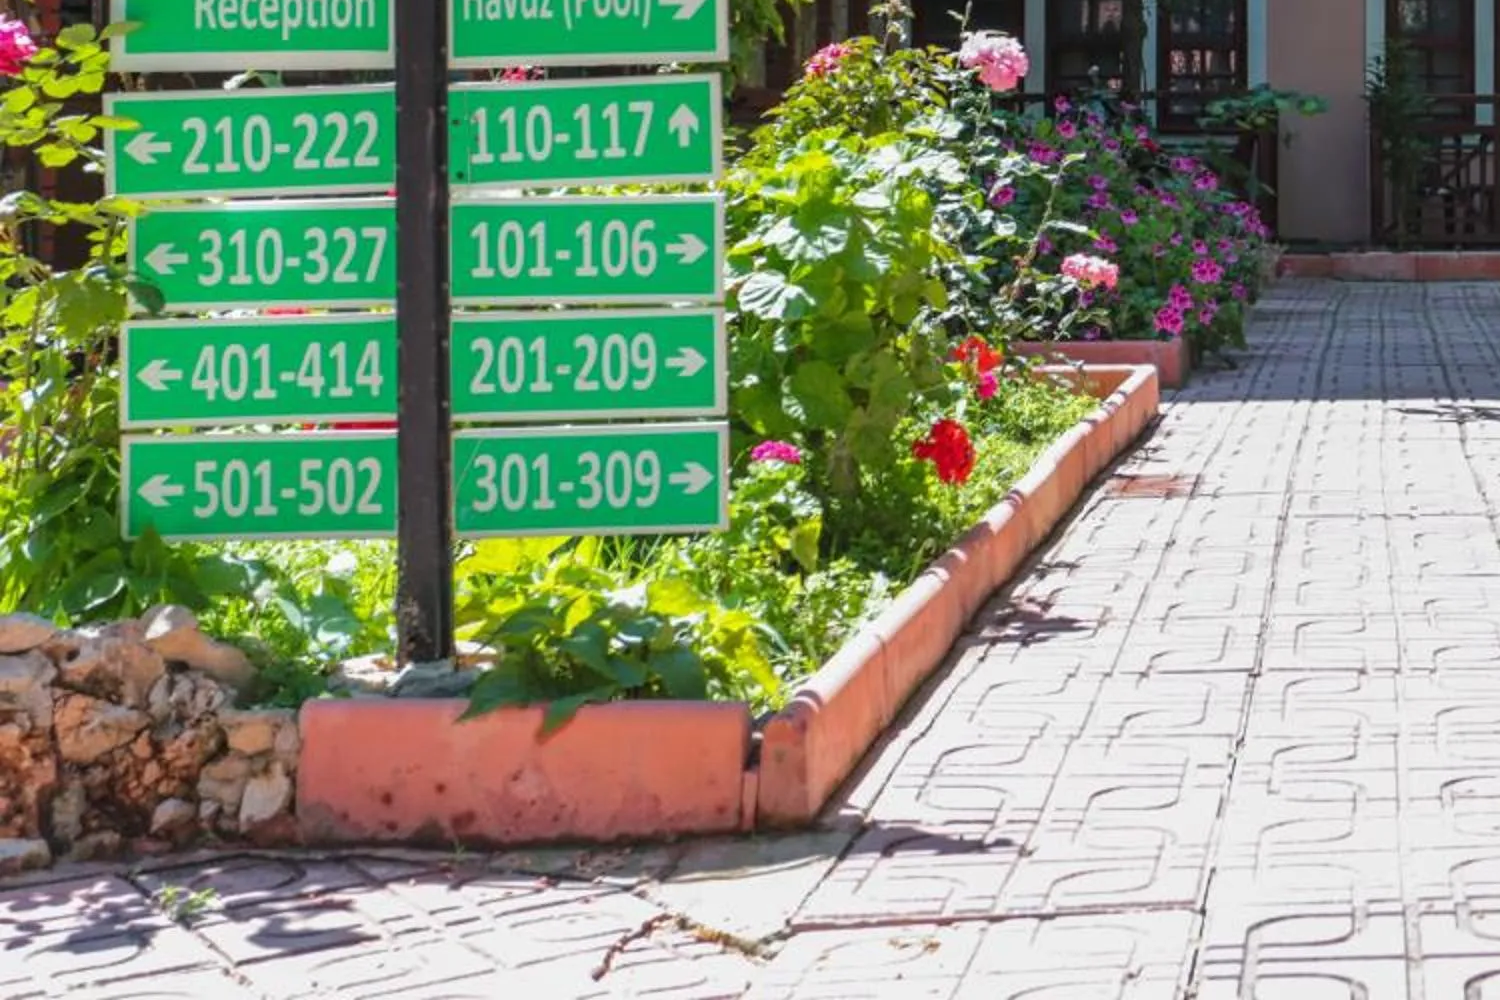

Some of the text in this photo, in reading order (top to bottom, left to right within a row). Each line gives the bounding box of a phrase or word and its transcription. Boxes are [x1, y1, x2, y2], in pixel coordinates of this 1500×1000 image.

[183, 111, 379, 173] 210-222
[471, 101, 653, 164] 110-117
[199, 227, 386, 286] 310-327
[472, 220, 657, 277] 101-106
[192, 341, 383, 400] 401-414
[471, 333, 656, 393] 201-209
[194, 458, 381, 517] 501-502
[473, 451, 660, 511] 301-309
